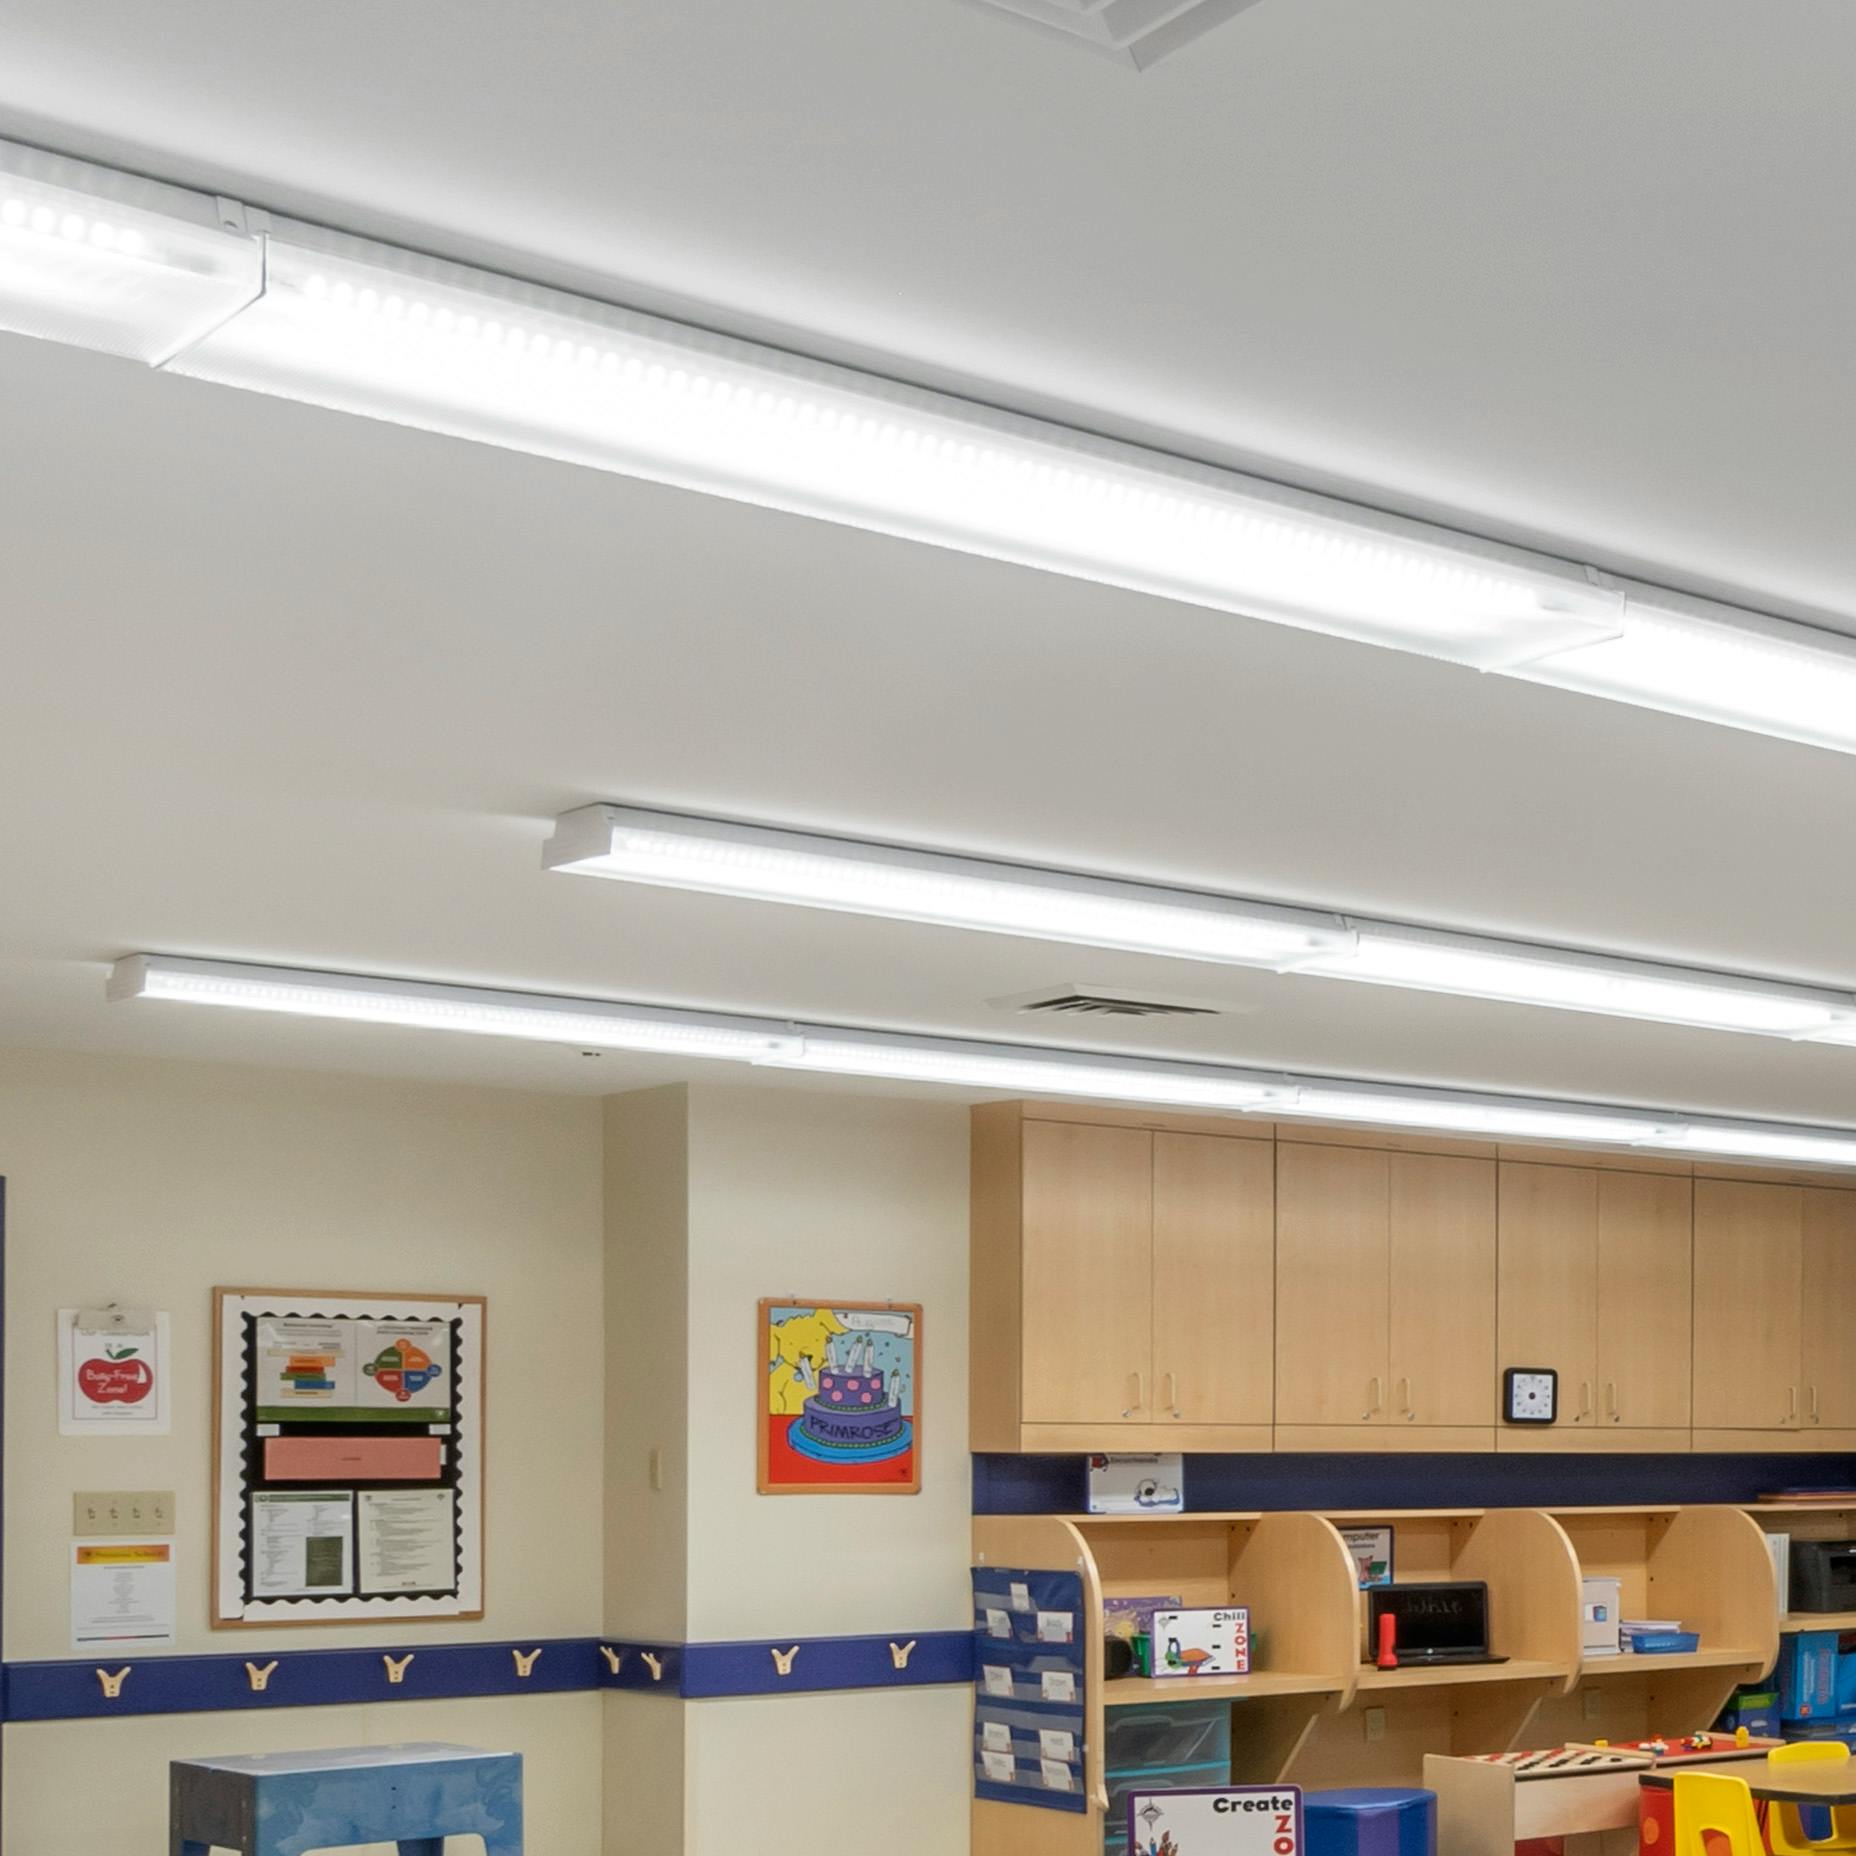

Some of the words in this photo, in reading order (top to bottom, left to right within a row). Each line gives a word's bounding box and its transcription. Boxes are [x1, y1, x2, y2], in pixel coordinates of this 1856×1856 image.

[810, 1415, 899, 1440] PRIMROSE
[1213, 1612, 1246, 1622] Chill
[1234, 1622, 1248, 1671] ZONE
[1212, 1795, 1294, 1814] Create
